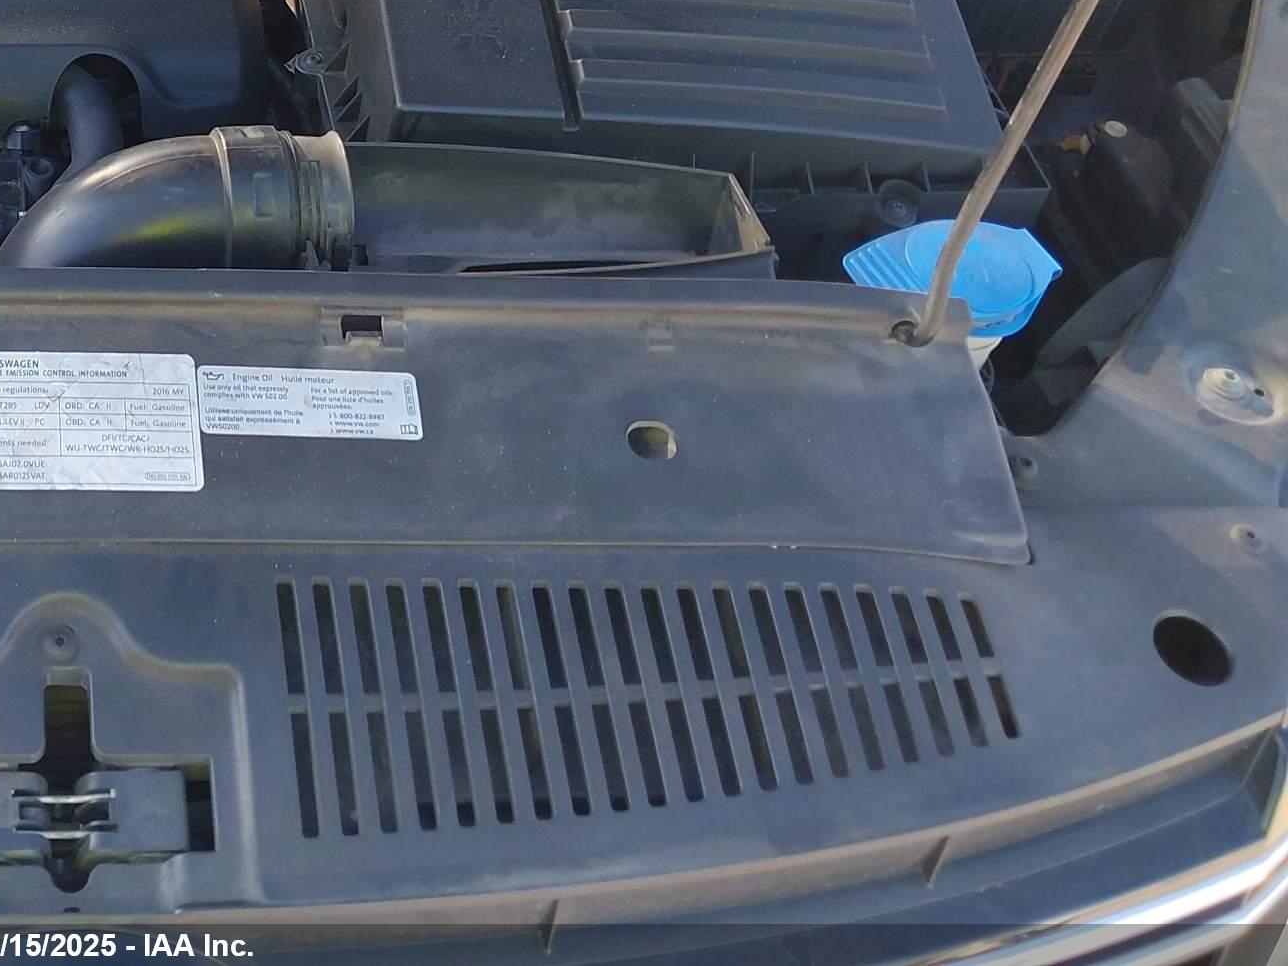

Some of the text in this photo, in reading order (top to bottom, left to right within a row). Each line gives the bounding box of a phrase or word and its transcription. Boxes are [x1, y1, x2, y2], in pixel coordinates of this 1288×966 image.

[5, 369, 40, 377] EMISSION
[78, 370, 128, 378] INFORMATION
[232, 373, 335, 385] Engine Oil Huile moteur
[152, 387, 170, 395] 2016
[217, 384, 232, 392] only
[242, 384, 257, 392] that
[258, 385, 289, 393] expressly
[348, 388, 379, 396] approved
[203, 392, 233, 400] complies
[88, 402, 100, 410] CA
[152, 402, 185, 412] Gasoline
[34, 418, 45, 426] PC
[89, 418, 101, 426] CA
[152, 419, 187, 428] Gasoline
[205, 415, 216, 423] qui
